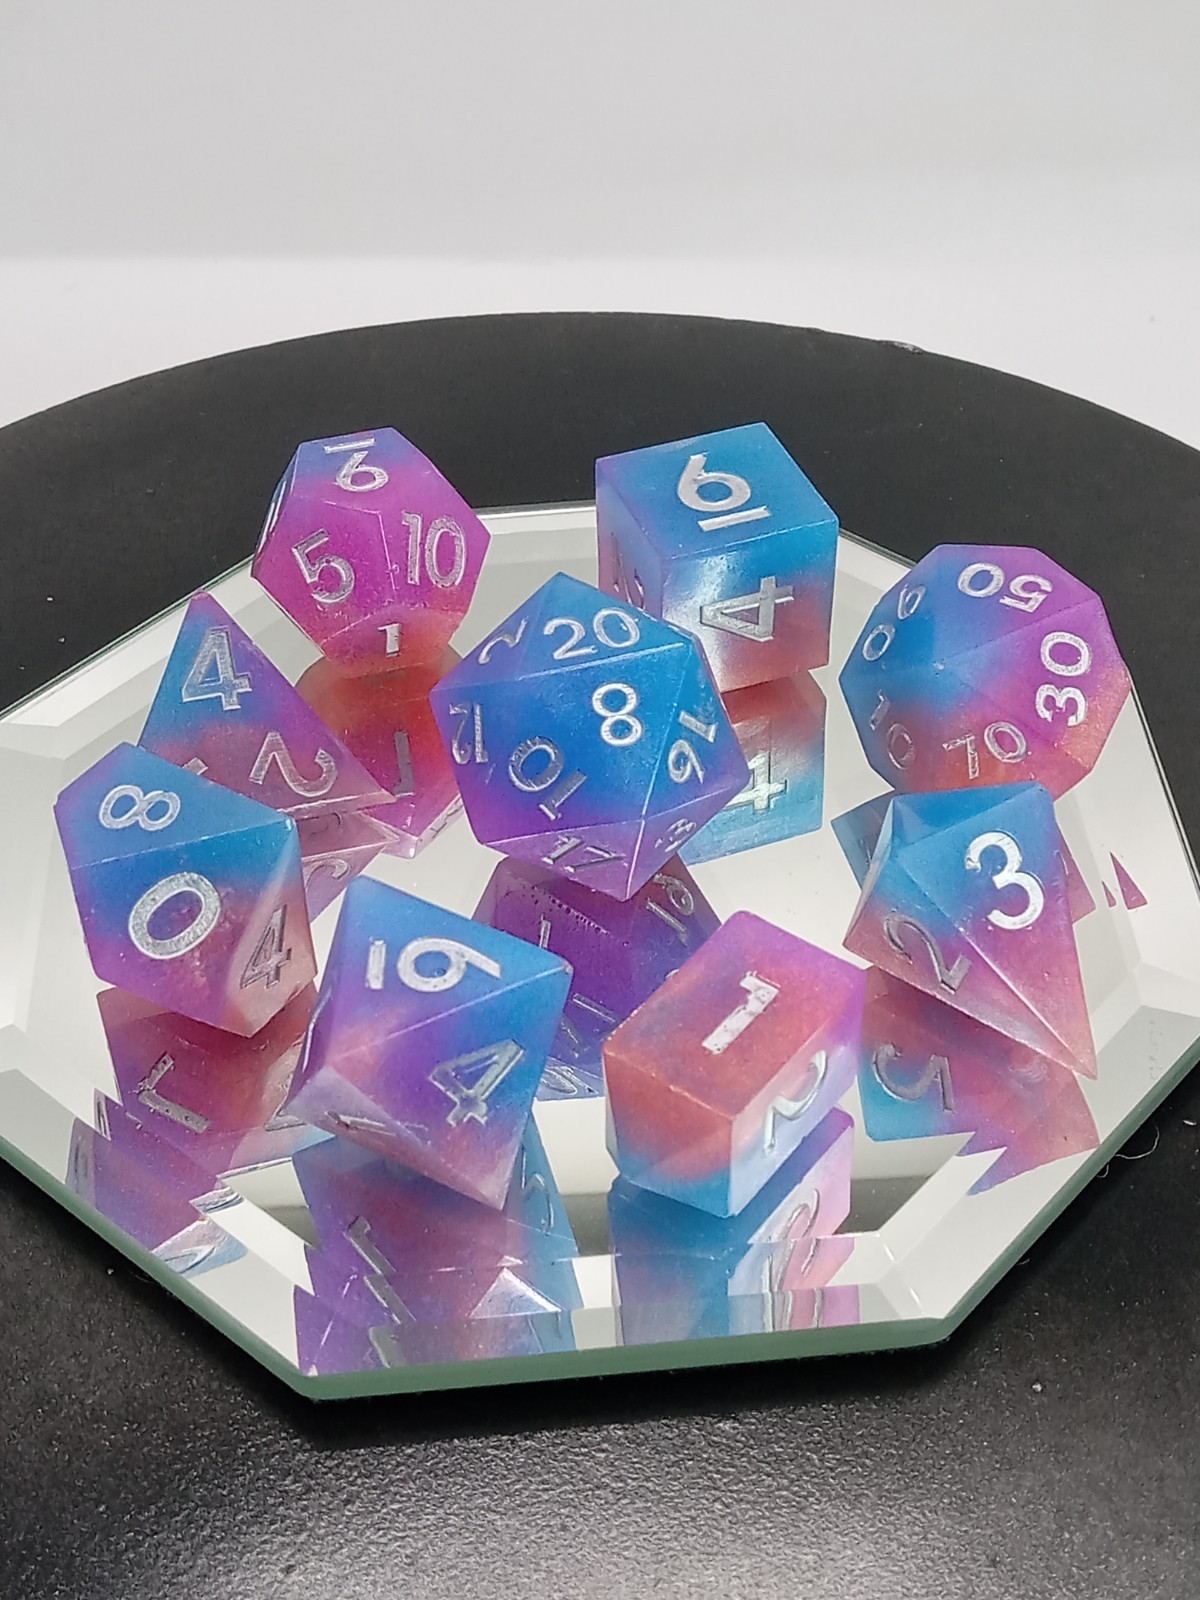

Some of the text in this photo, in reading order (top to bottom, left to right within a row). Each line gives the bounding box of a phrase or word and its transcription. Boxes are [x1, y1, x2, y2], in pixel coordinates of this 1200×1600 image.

[677, 452, 772, 532] 6
[292, 528, 355, 604] 5
[401, 511, 467, 589] 10
[377, 623, 402, 657] 1
[543, 608, 642, 661] 20
[700, 575, 794, 642] 4
[182, 626, 252, 711] 4
[1035, 631, 1093, 727] 30
[592, 682, 644, 748] 8
[943, 722, 1028, 779] 70
[99, 785, 181, 831] 8
[128, 871, 222, 960] 0
[964, 830, 1045, 930] 3
[240, 904, 292, 989] 4
[883, 908, 972, 995] 2
[701, 971, 781, 1056] 1
[427, 1038, 526, 1128] 4
[763, 1050, 827, 1158] 2
